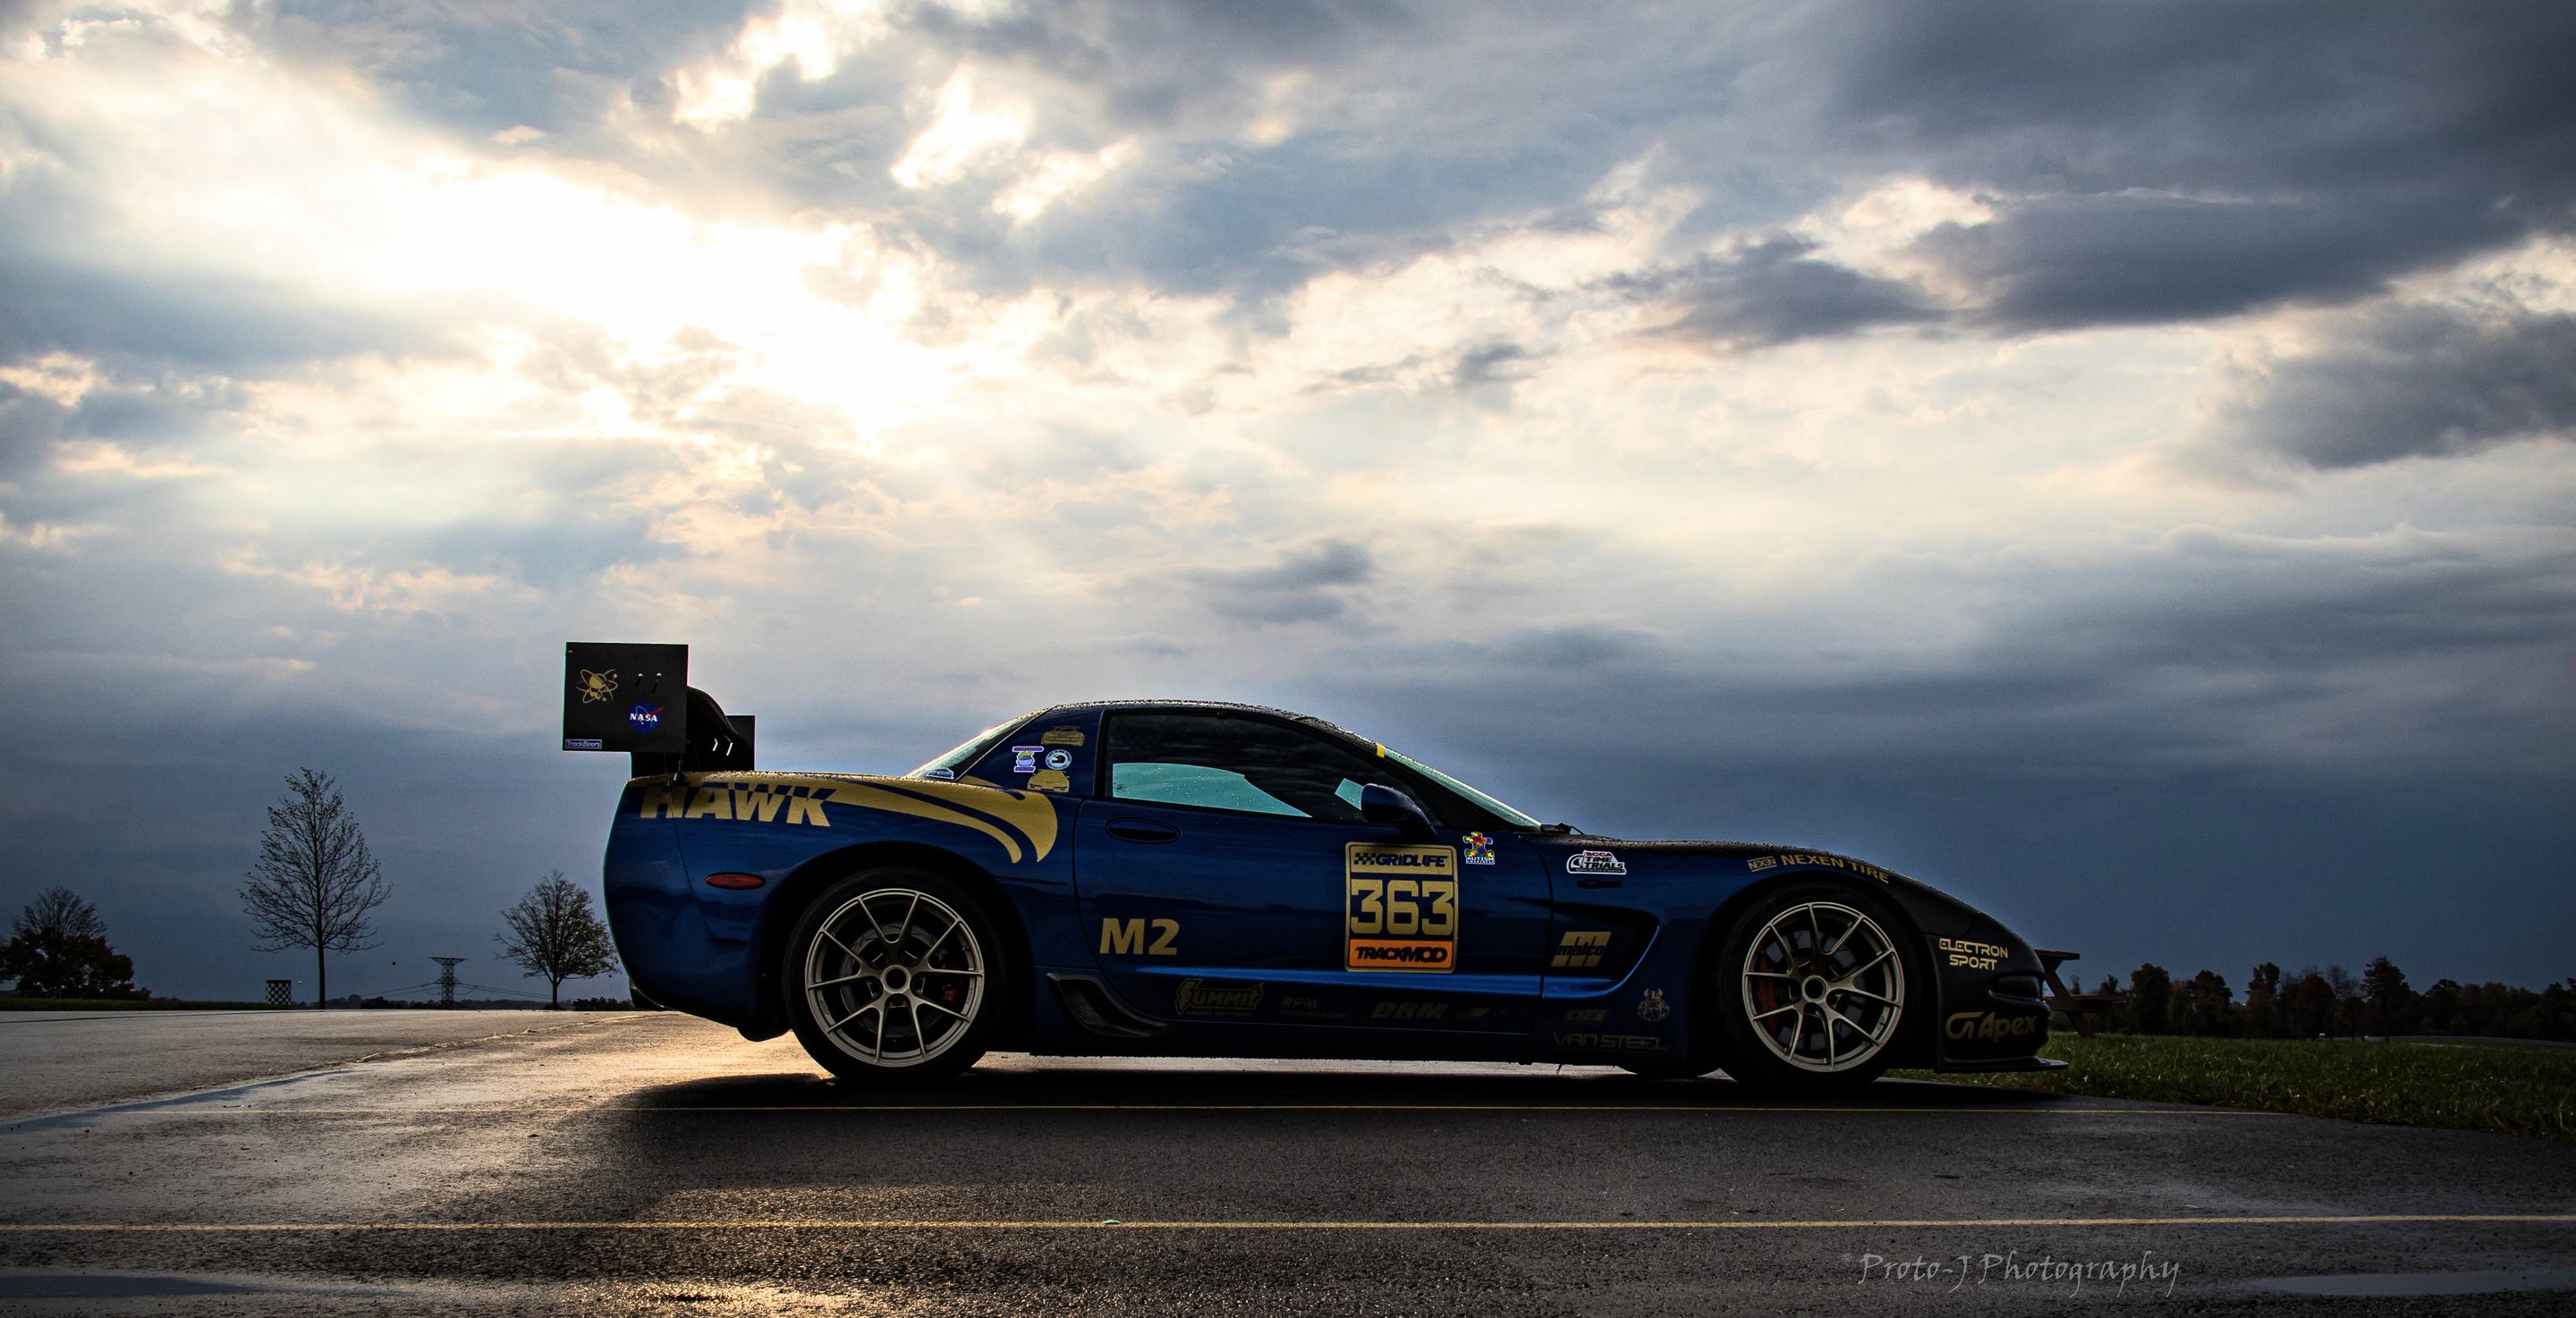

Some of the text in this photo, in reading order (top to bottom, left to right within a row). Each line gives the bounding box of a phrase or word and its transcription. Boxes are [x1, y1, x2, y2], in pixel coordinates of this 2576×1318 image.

[629, 713, 658, 723] NASA
[640, 782, 837, 827] HAWK
[1376, 853, 1448, 867] GRIDLIFE
[1780, 854, 1890, 884] NEXEN TIRE
[1351, 879, 1453, 936] 363
[1099, 917, 1180, 955] M2
[1938, 938, 2009, 959] ELECTRON
[1949, 954, 1998, 971] SPORT
